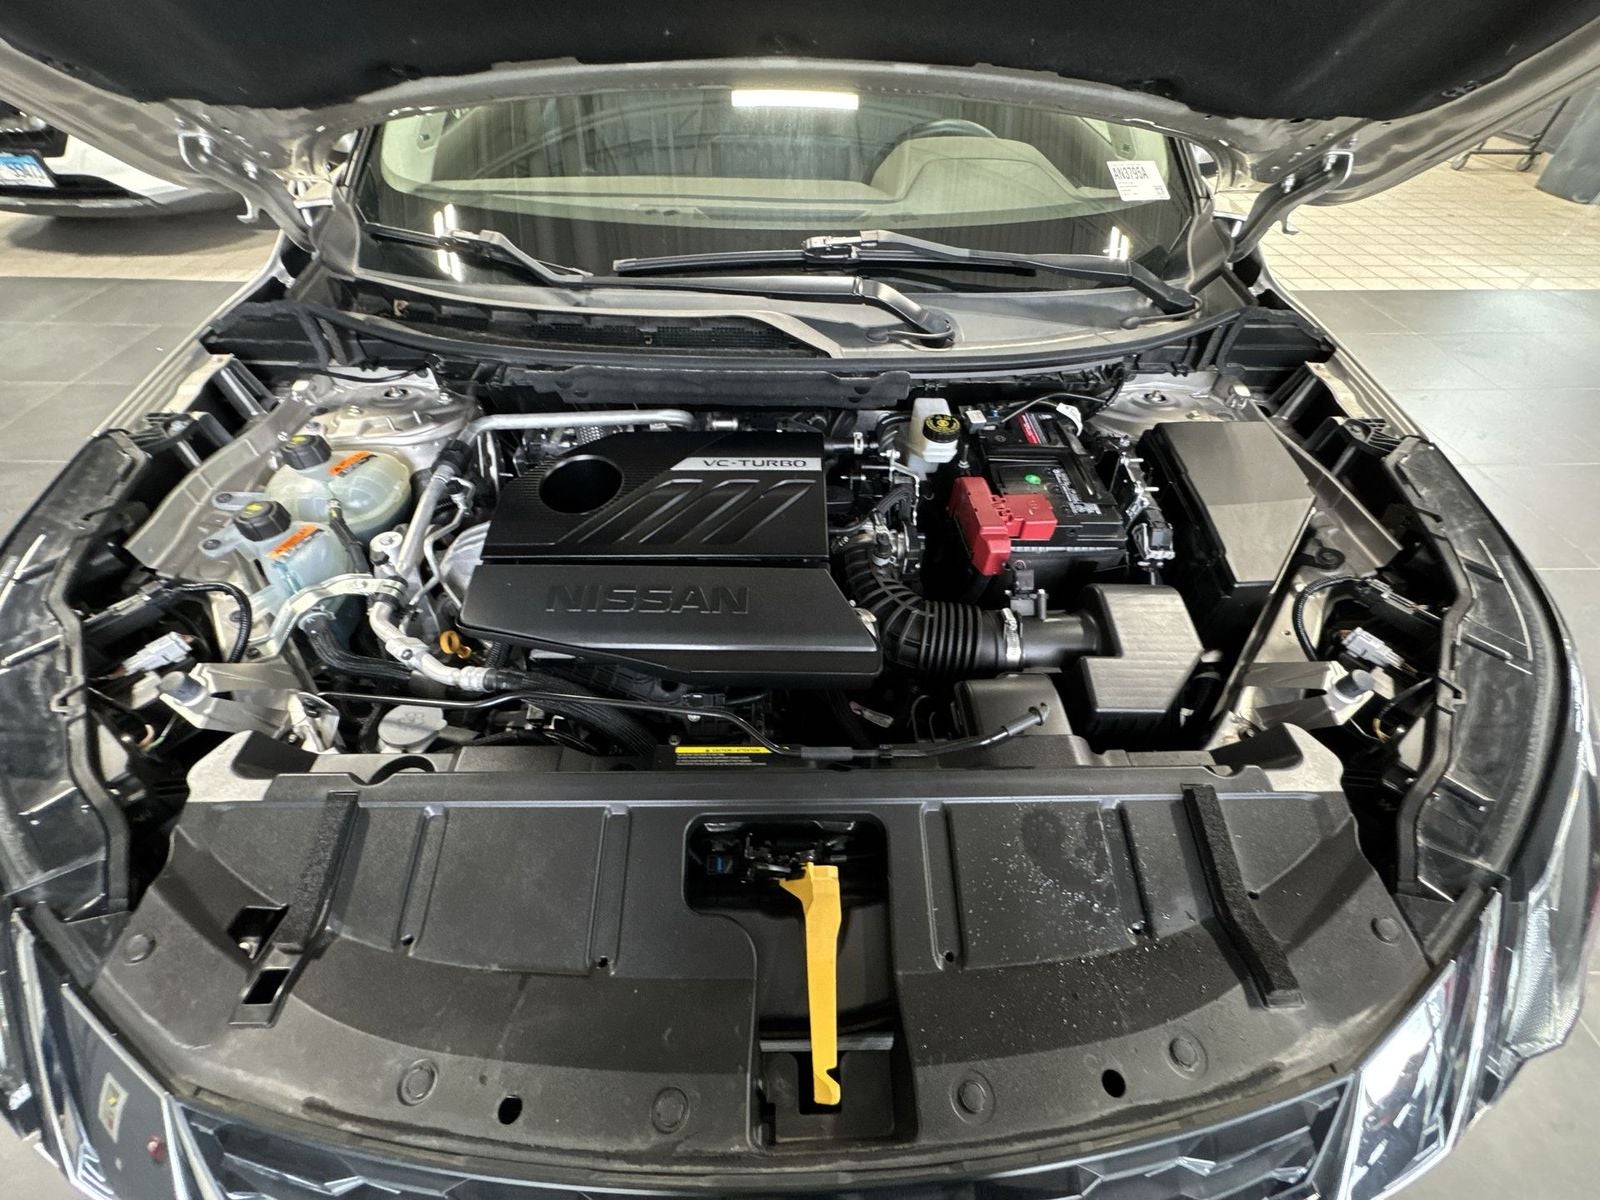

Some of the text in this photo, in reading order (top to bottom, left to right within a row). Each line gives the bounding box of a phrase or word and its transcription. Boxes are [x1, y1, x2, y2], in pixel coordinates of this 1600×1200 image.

[1112, 166, 1149, 180] AN3795A
[703, 459, 807, 468] VC-TURBO
[545, 584, 750, 615] NISSAN
